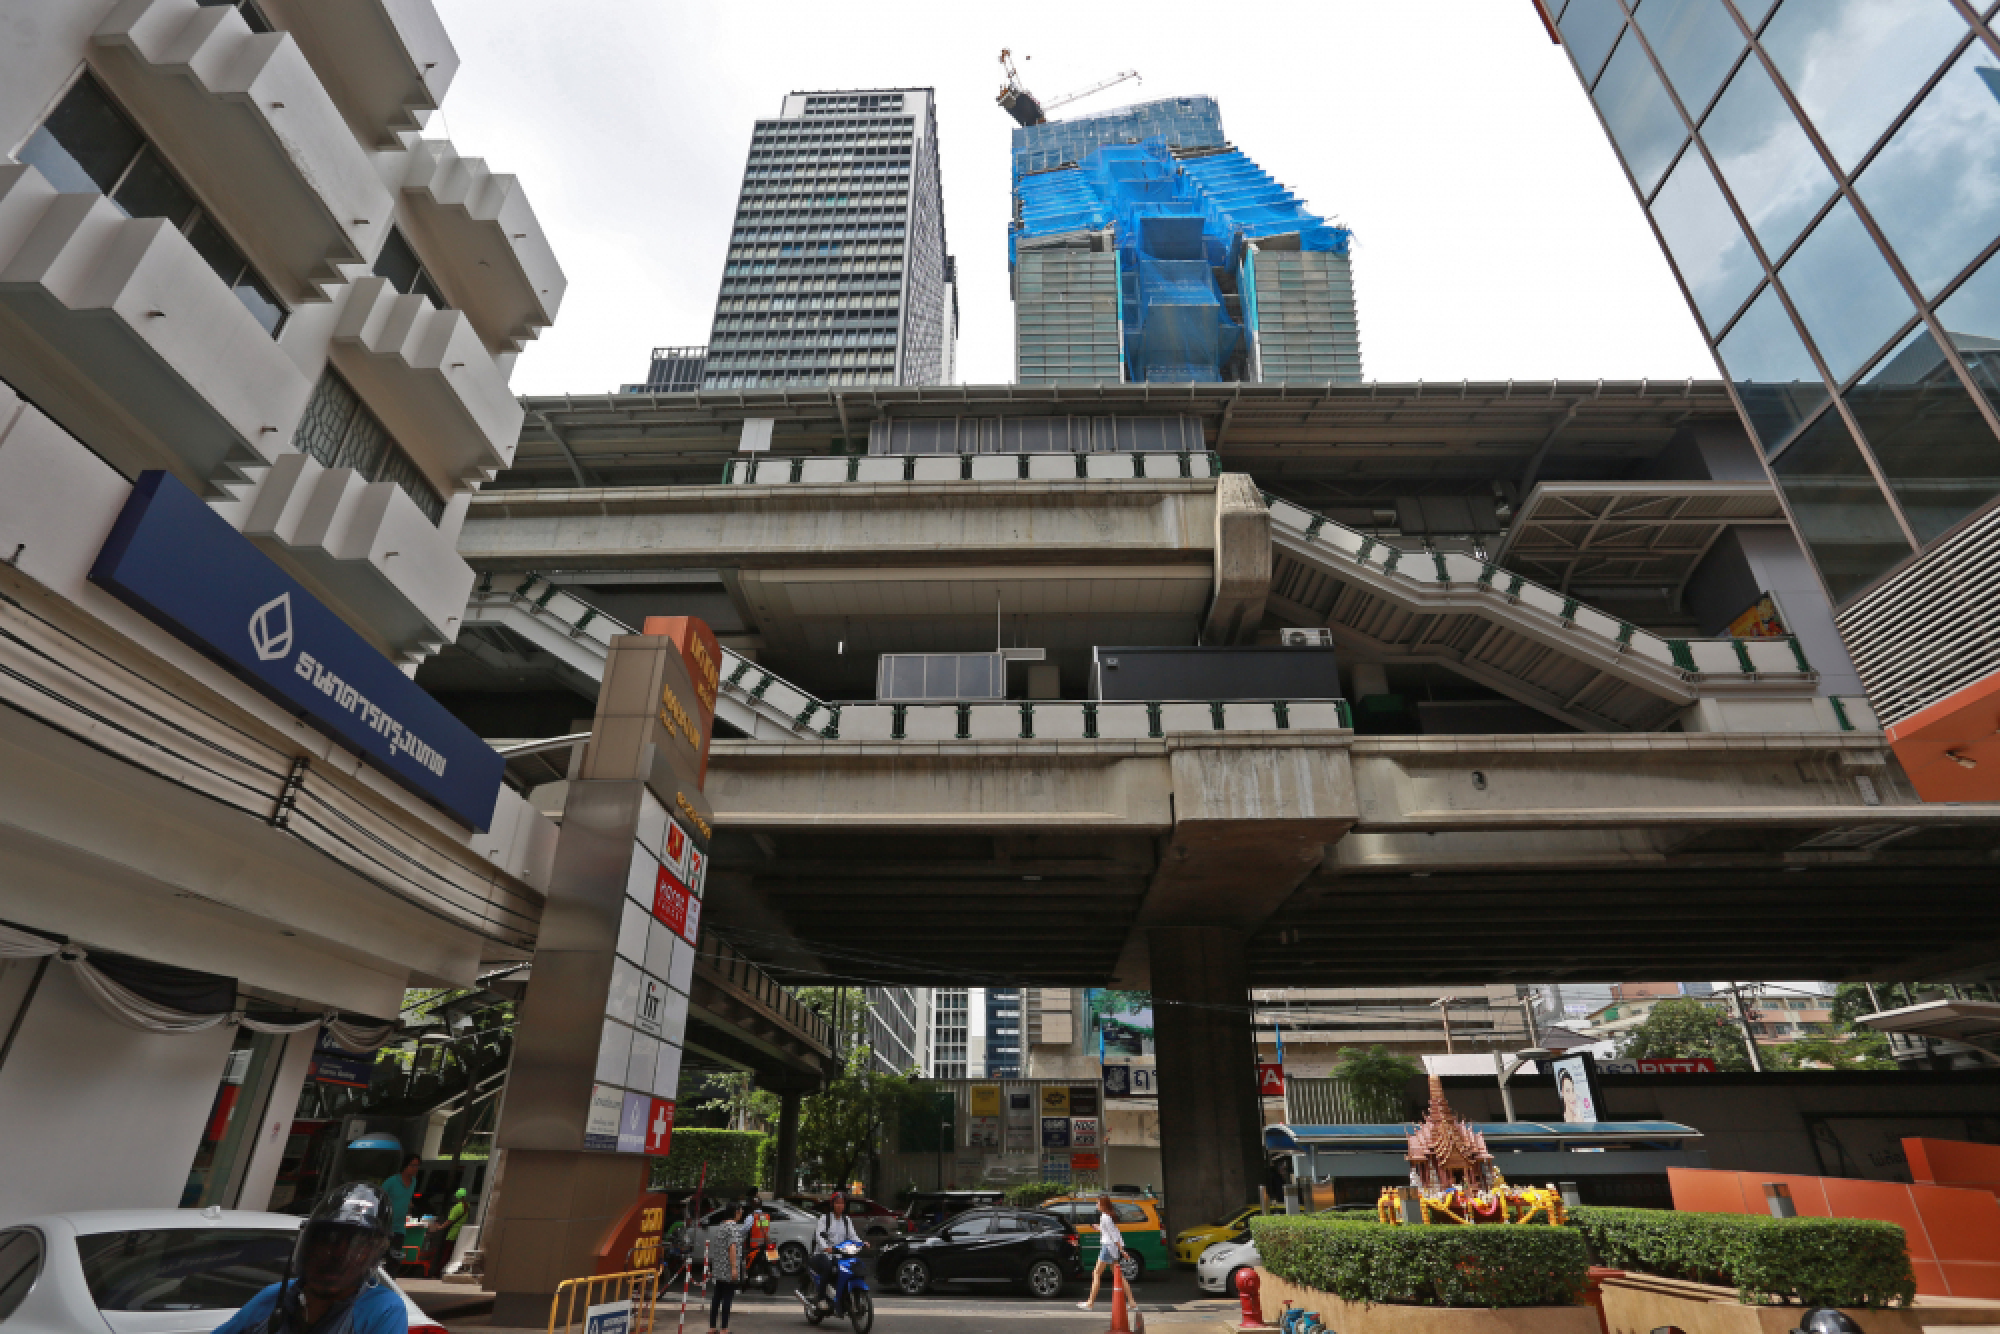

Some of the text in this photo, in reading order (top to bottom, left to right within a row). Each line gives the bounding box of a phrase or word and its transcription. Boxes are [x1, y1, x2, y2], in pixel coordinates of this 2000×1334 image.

[294, 651, 447, 777] ธนาคารกรุงเทพ
